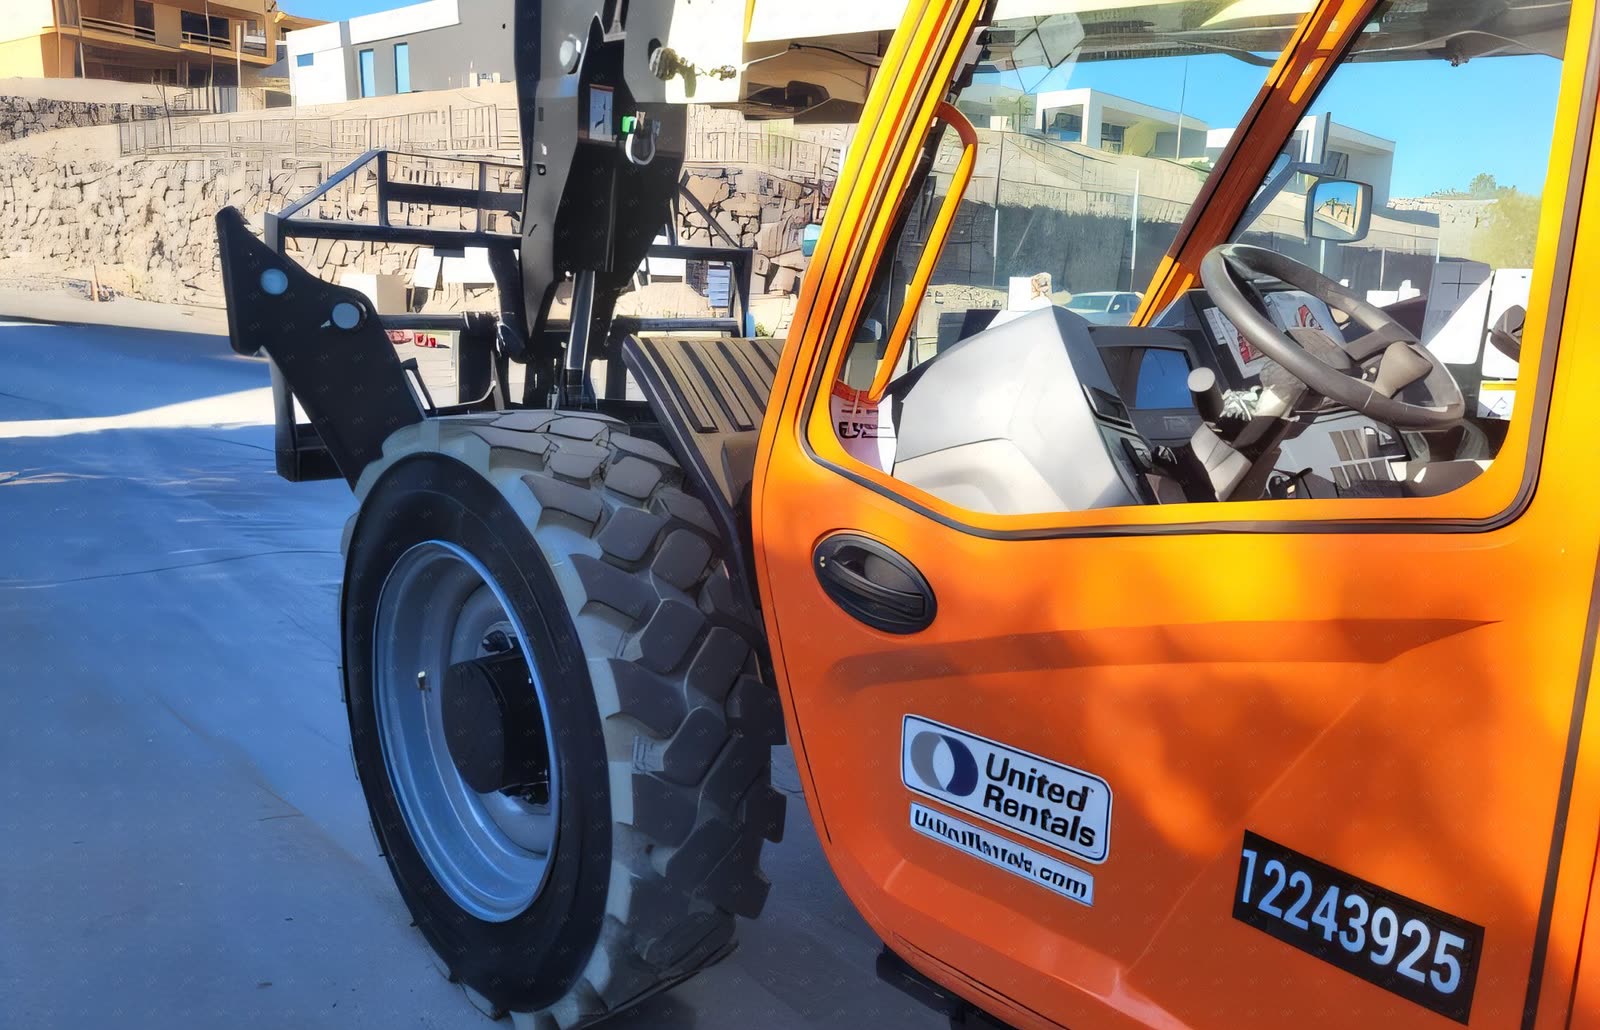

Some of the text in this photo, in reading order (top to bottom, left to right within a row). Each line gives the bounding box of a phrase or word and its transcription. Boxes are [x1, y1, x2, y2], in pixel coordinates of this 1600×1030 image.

[985, 753, 1089, 812] United
[983, 784, 1096, 847] Rentals
[1242, 849, 1465, 994] 12243925
